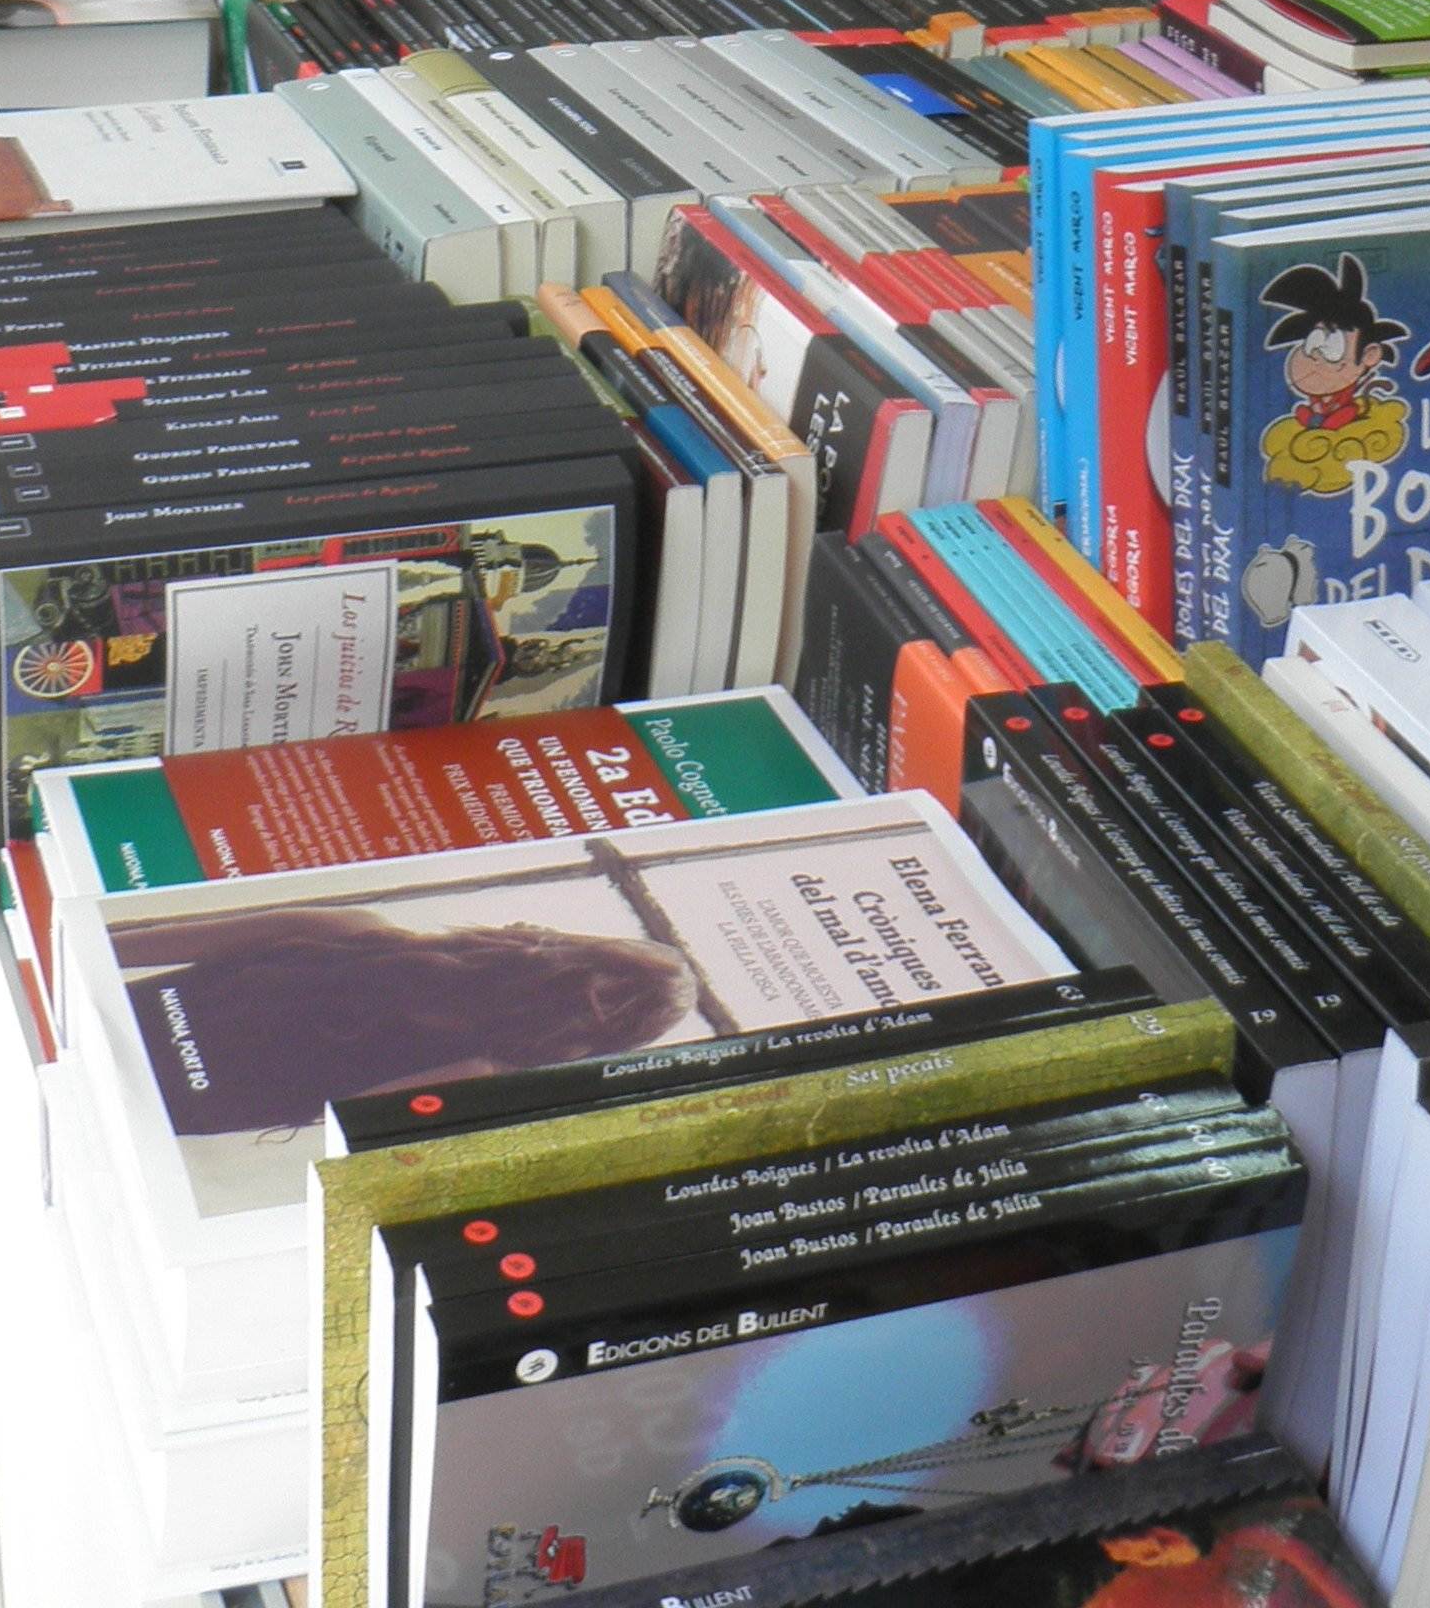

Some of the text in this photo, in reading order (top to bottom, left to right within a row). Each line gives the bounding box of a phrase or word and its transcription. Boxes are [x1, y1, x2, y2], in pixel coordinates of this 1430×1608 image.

[1102, 211, 1114, 275] MARCO
[1123, 231, 1137, 367] VICENT MARCO
[104, 501, 245, 526] JOHN MORTIMER
[1172, 448, 1195, 640] BOLES DEL DRAC
[1210, 517, 1233, 635] DEL DRAC
[271, 631, 302, 678] JOHN
[331, 591, 366, 713] Los juicios de
[442, 762, 469, 790] PRIX
[585, 746, 632, 785] 2a
[645, 717, 689, 759] Paolo
[485, 782, 527, 830] PREMIO
[496, 737, 573, 838] QUE TRIOMFA
[537, 735, 613, 832] UN FENOMEN
[790, 872, 867, 948] del mal
[851, 890, 942, 992] Cròniques
[888, 855, 1006, 988] Elena Ferran
[159, 986, 210, 1090] NAVONA PORT BO
[602, 1055, 672, 1079] Lourdes
[767, 1031, 793, 1050] La
[796, 1022, 860, 1045] revolta
[863, 1010, 933, 1034] d'Adam
[664, 1121, 1011, 1202] Lourdes Boïgues La revolta d'Adam
[729, 1155, 1029, 1235] Joan Bustos Paraules de Júlia
[739, 1190, 1043, 1271] Joan Bustos Paraules de Júlia
[586, 1302, 830, 1367] EDICIONS DEL BULLENT
